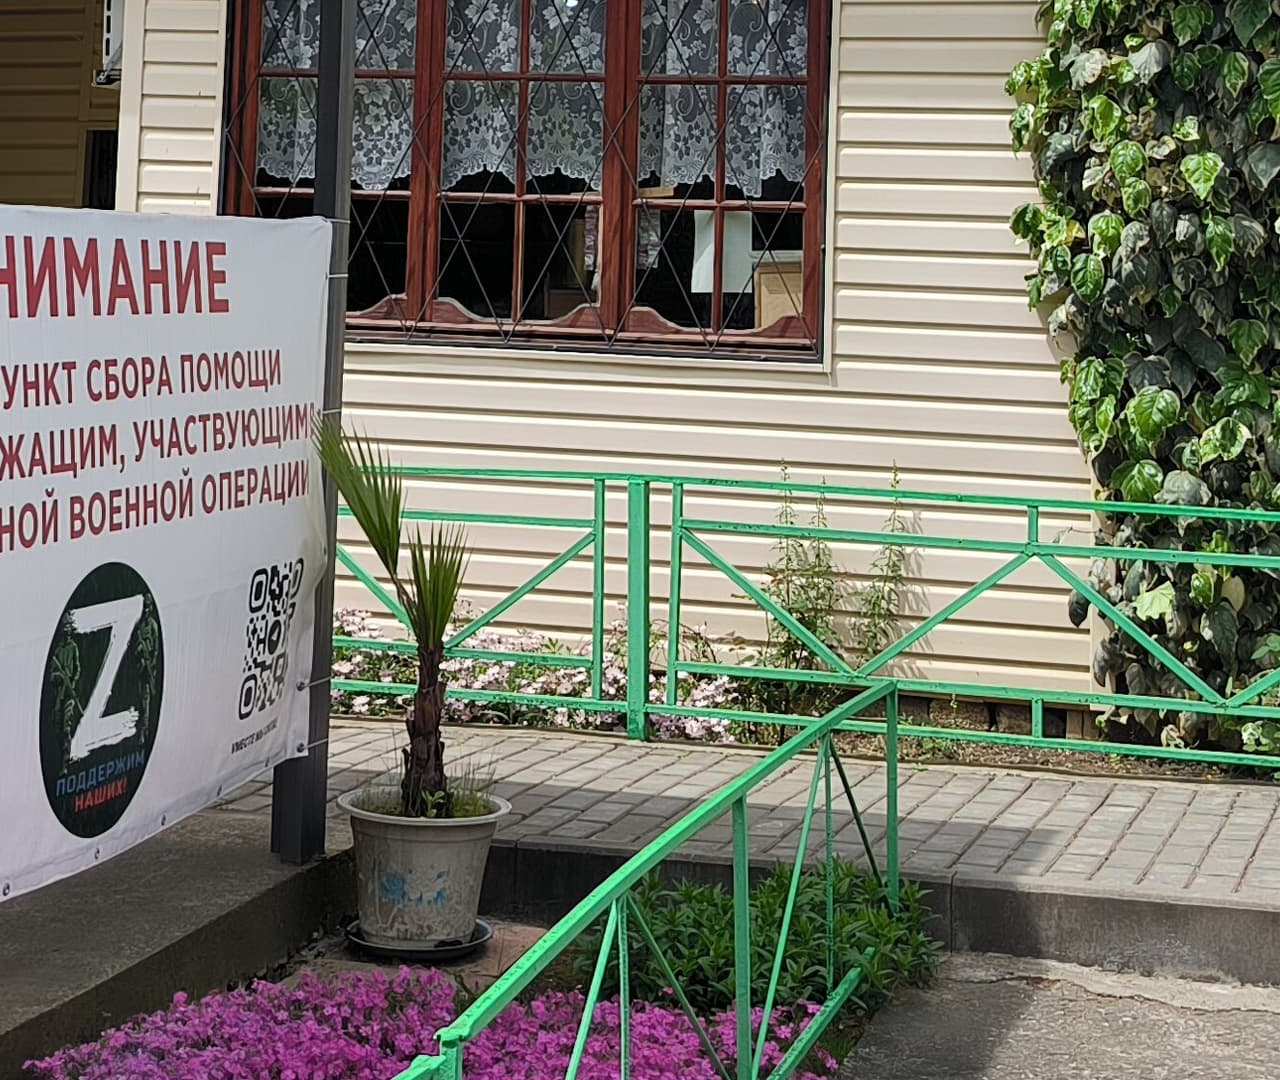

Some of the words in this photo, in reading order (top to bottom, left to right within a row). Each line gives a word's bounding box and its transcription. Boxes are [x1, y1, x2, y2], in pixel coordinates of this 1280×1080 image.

[87, 355, 173, 407] СБОРА
[180, 349, 282, 393] ПОМОЩИ
[70, 467, 193, 540] ВОЕННОЙ
[202, 459, 310, 514] ОПЕРАЦИИ
[70, 593, 144, 761] Z
[56, 749, 145, 797] ПОДДЕРЖИМ
[74, 777, 128, 813] НАШИХ!
